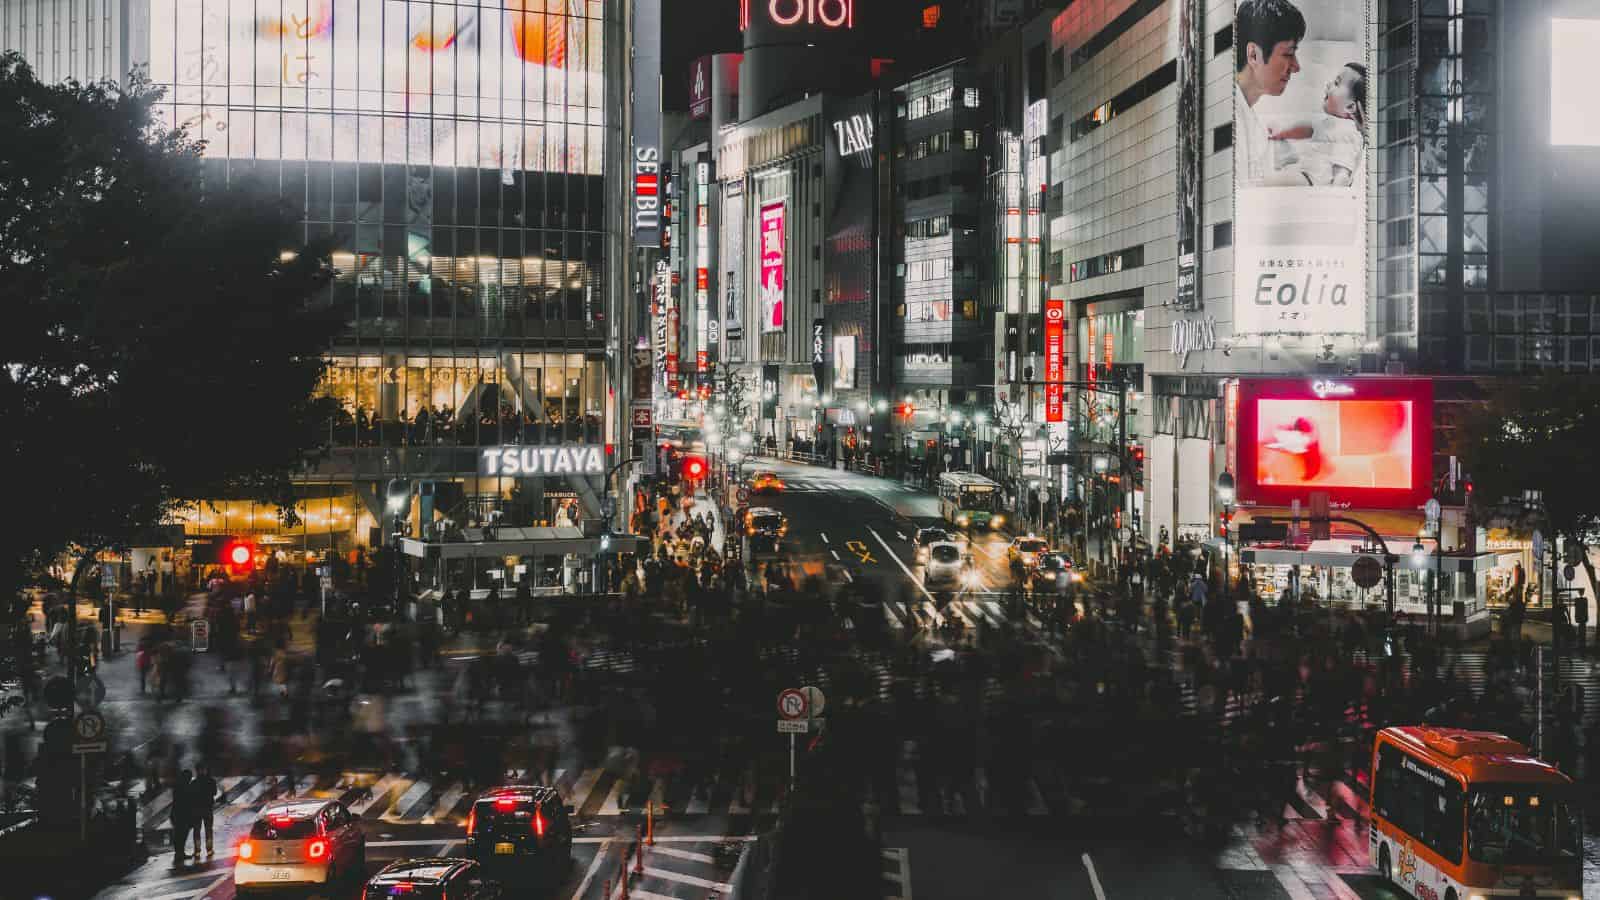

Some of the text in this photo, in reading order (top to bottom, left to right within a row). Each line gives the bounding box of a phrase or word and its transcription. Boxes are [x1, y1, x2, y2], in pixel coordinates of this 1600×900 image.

[636, 146, 658, 228] SEIBU
[1255, 273, 1348, 306] Eolia
[813, 325, 824, 363] ZARA
[483, 446, 604, 475] TSUTAYA
